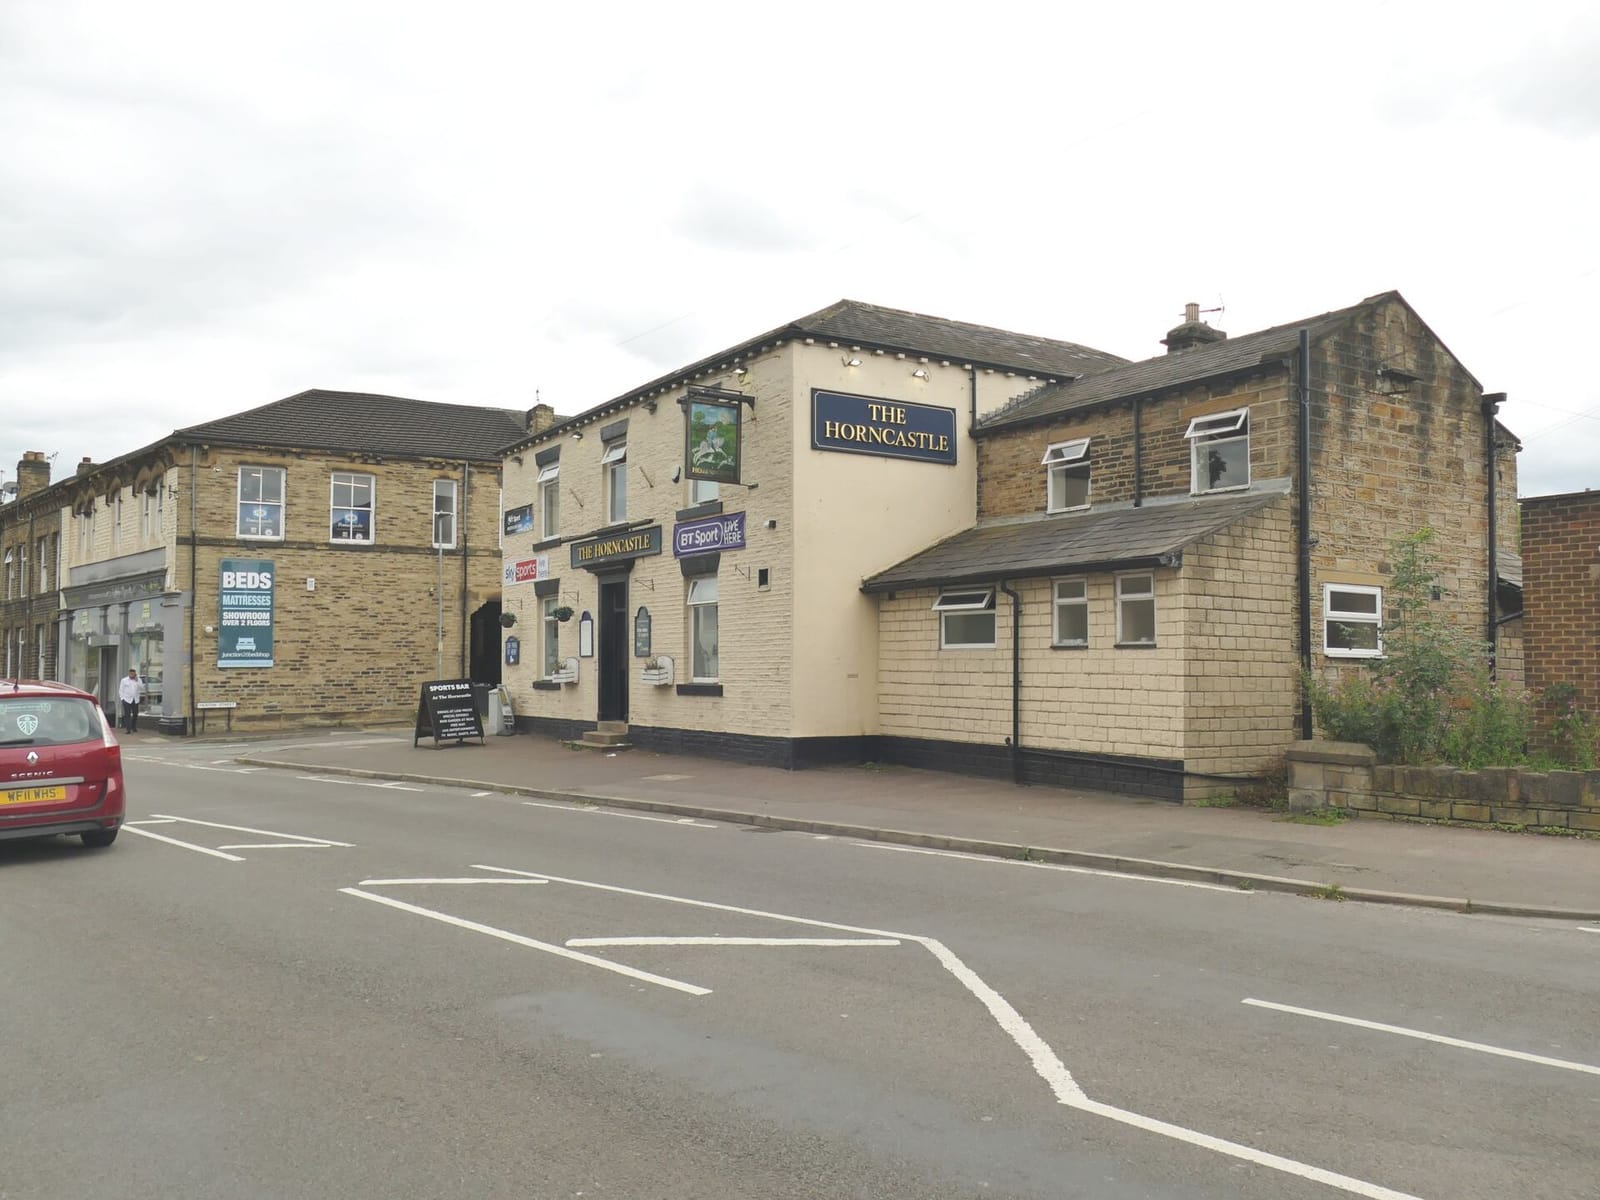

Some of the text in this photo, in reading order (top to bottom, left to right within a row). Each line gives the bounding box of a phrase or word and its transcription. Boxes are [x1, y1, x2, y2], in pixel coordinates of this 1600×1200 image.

[868, 403, 907, 424] THE
[825, 420, 949, 451] HORNCASTLE
[724, 519, 739, 533] LIVE
[680, 527, 718, 546] BT Sport
[723, 531, 742, 545] HERE
[578, 534, 650, 560] THE HORNCASTLE
[516, 563, 536, 580] sports
[222, 571, 272, 589] BEDS
[222, 594, 271, 606] MATTRESSES
[222, 611, 270, 620] SHOWROOM
[429, 684, 455, 692] SPORTS
[10, 770, 54, 778] SCENIC
[7, 788, 57, 802] WF11 WHS
